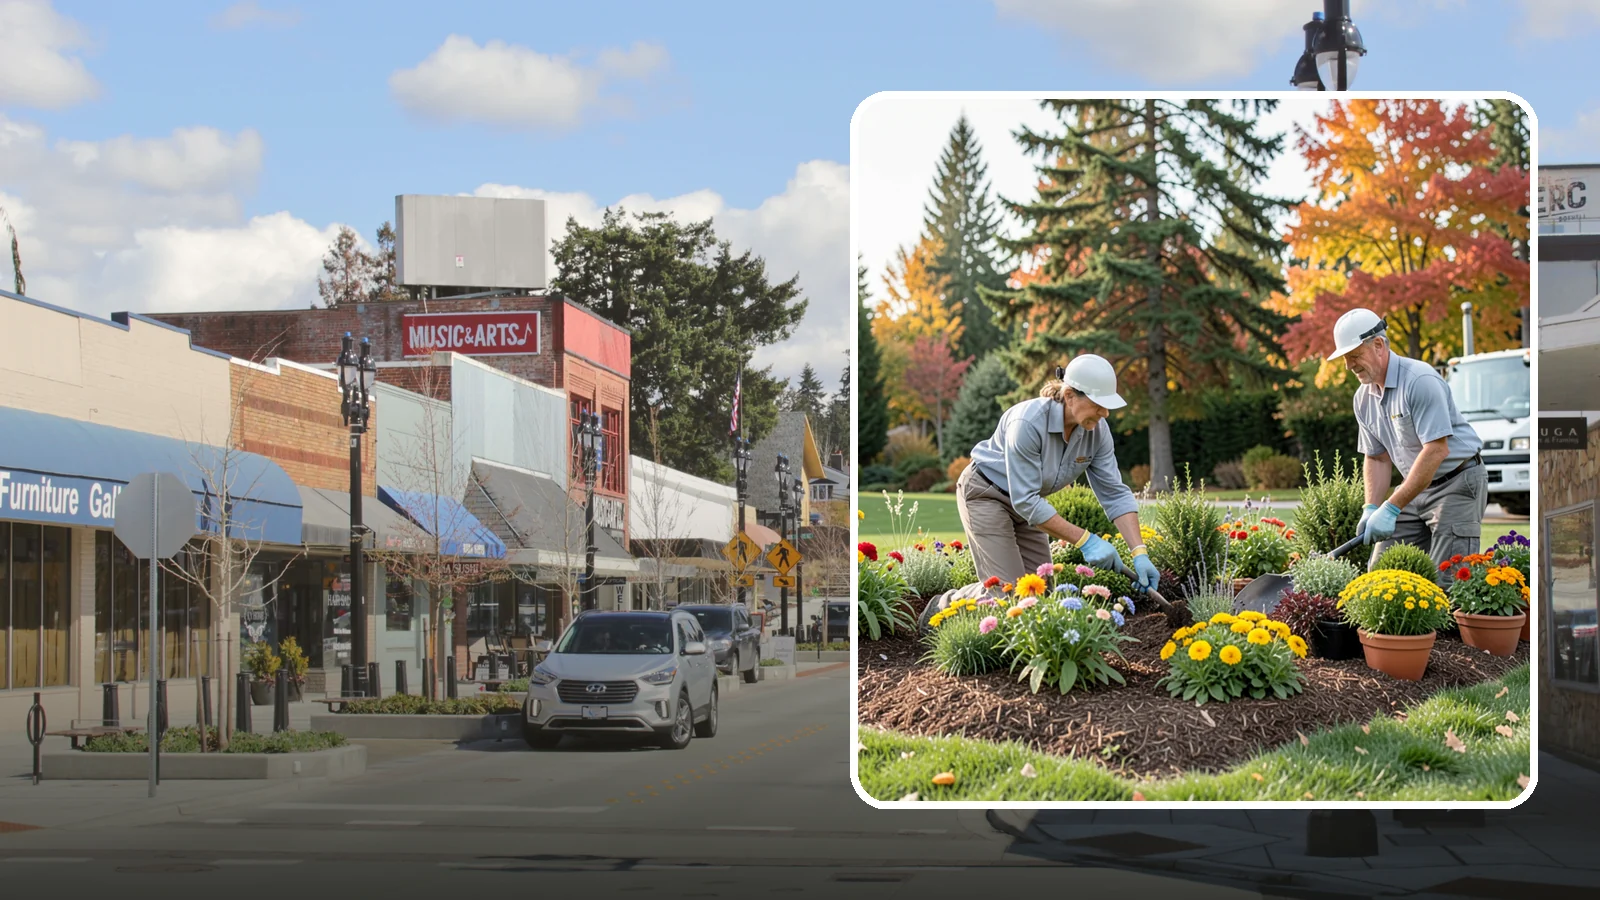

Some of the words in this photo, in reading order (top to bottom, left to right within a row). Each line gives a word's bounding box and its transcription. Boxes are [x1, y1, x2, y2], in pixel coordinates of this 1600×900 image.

[409, 323, 519, 348] MUSIC&ARTS
[0, 471, 79, 515] Furniture
[89, 482, 122, 519] Gal
